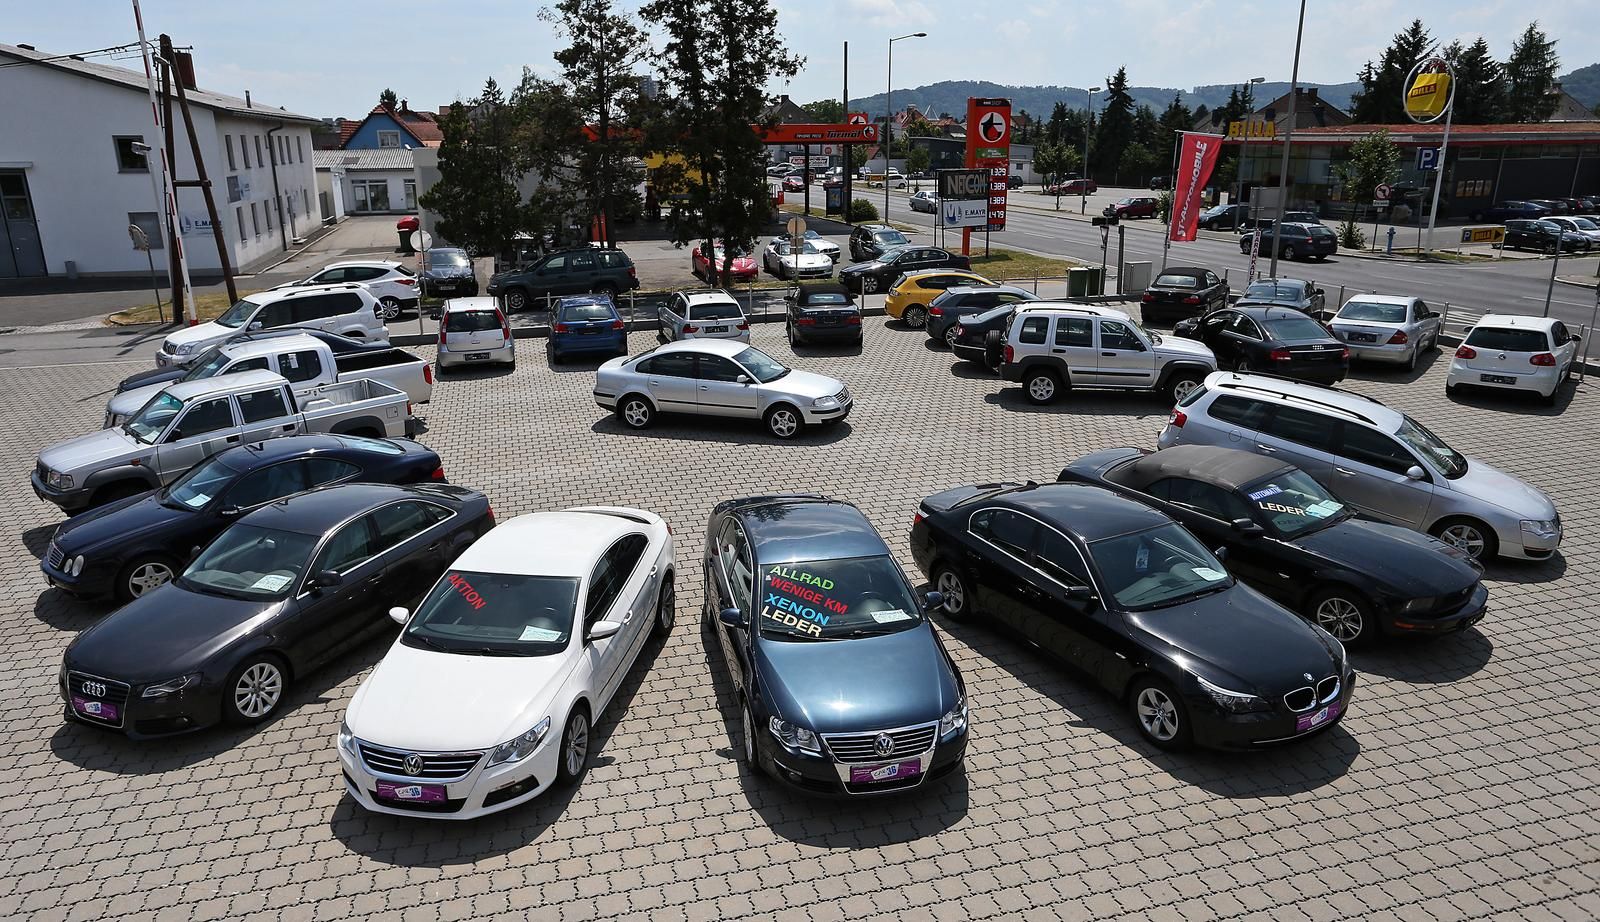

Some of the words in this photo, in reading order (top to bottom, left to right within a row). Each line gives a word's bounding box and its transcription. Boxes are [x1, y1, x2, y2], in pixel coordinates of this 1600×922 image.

[1412, 85, 1435, 96] BILLA
[1228, 120, 1275, 138] BILLA
[1420, 149, 1433, 169] P
[946, 174, 986, 195] NETCOM
[1258, 501, 1306, 517] LEDER
[769, 565, 835, 591] ALLRAD
[448, 573, 487, 610] AKTION
[770, 576, 825, 605] WENIGE
[823, 597, 849, 616] KM
[764, 592, 831, 626] XENON
[761, 605, 823, 638] LEDER
[886, 766, 897, 776] 36
[410, 787, 421, 797] 36
